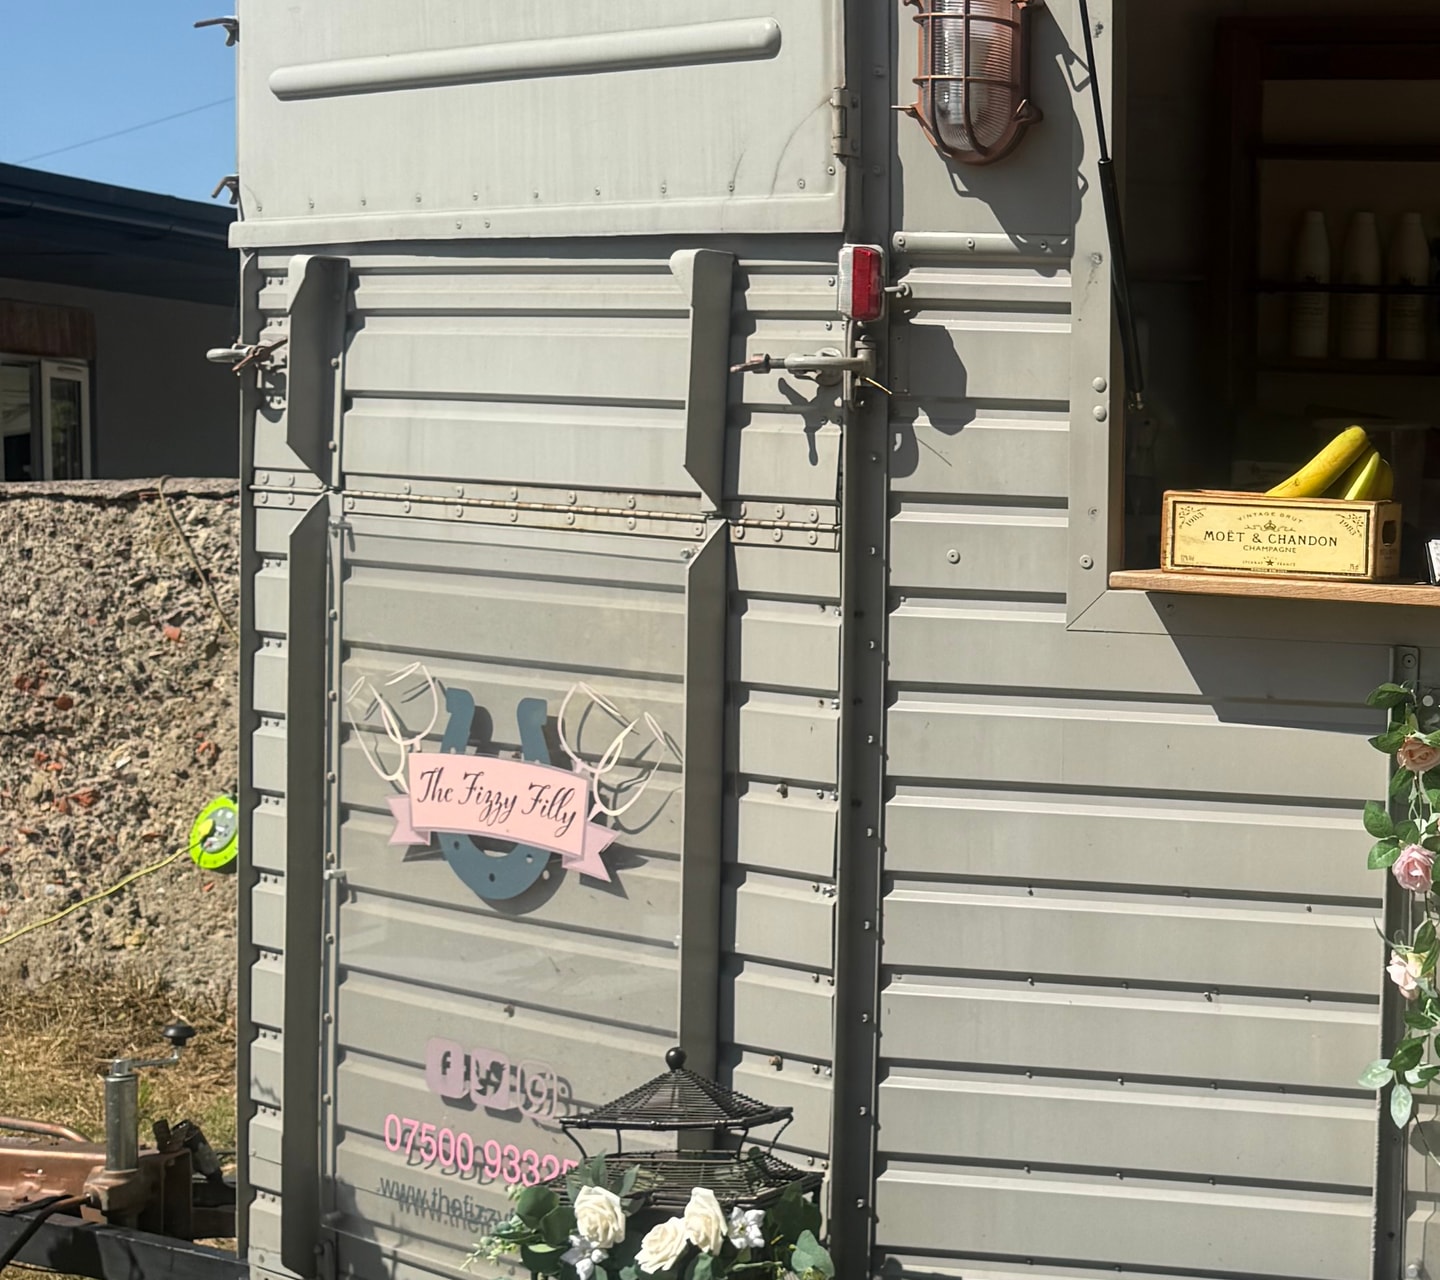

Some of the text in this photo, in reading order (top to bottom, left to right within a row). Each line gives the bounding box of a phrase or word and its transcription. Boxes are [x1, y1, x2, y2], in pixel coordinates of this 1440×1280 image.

[1237, 511, 1303, 524] VINTAGE BRUT
[1203, 528, 1338, 547] MOËT & CHANDON
[1243, 544, 1297, 554] CHAMPAGNE
[416, 766, 578, 838] The Fizzy Filly
[384, 1113, 475, 1172] 07500
